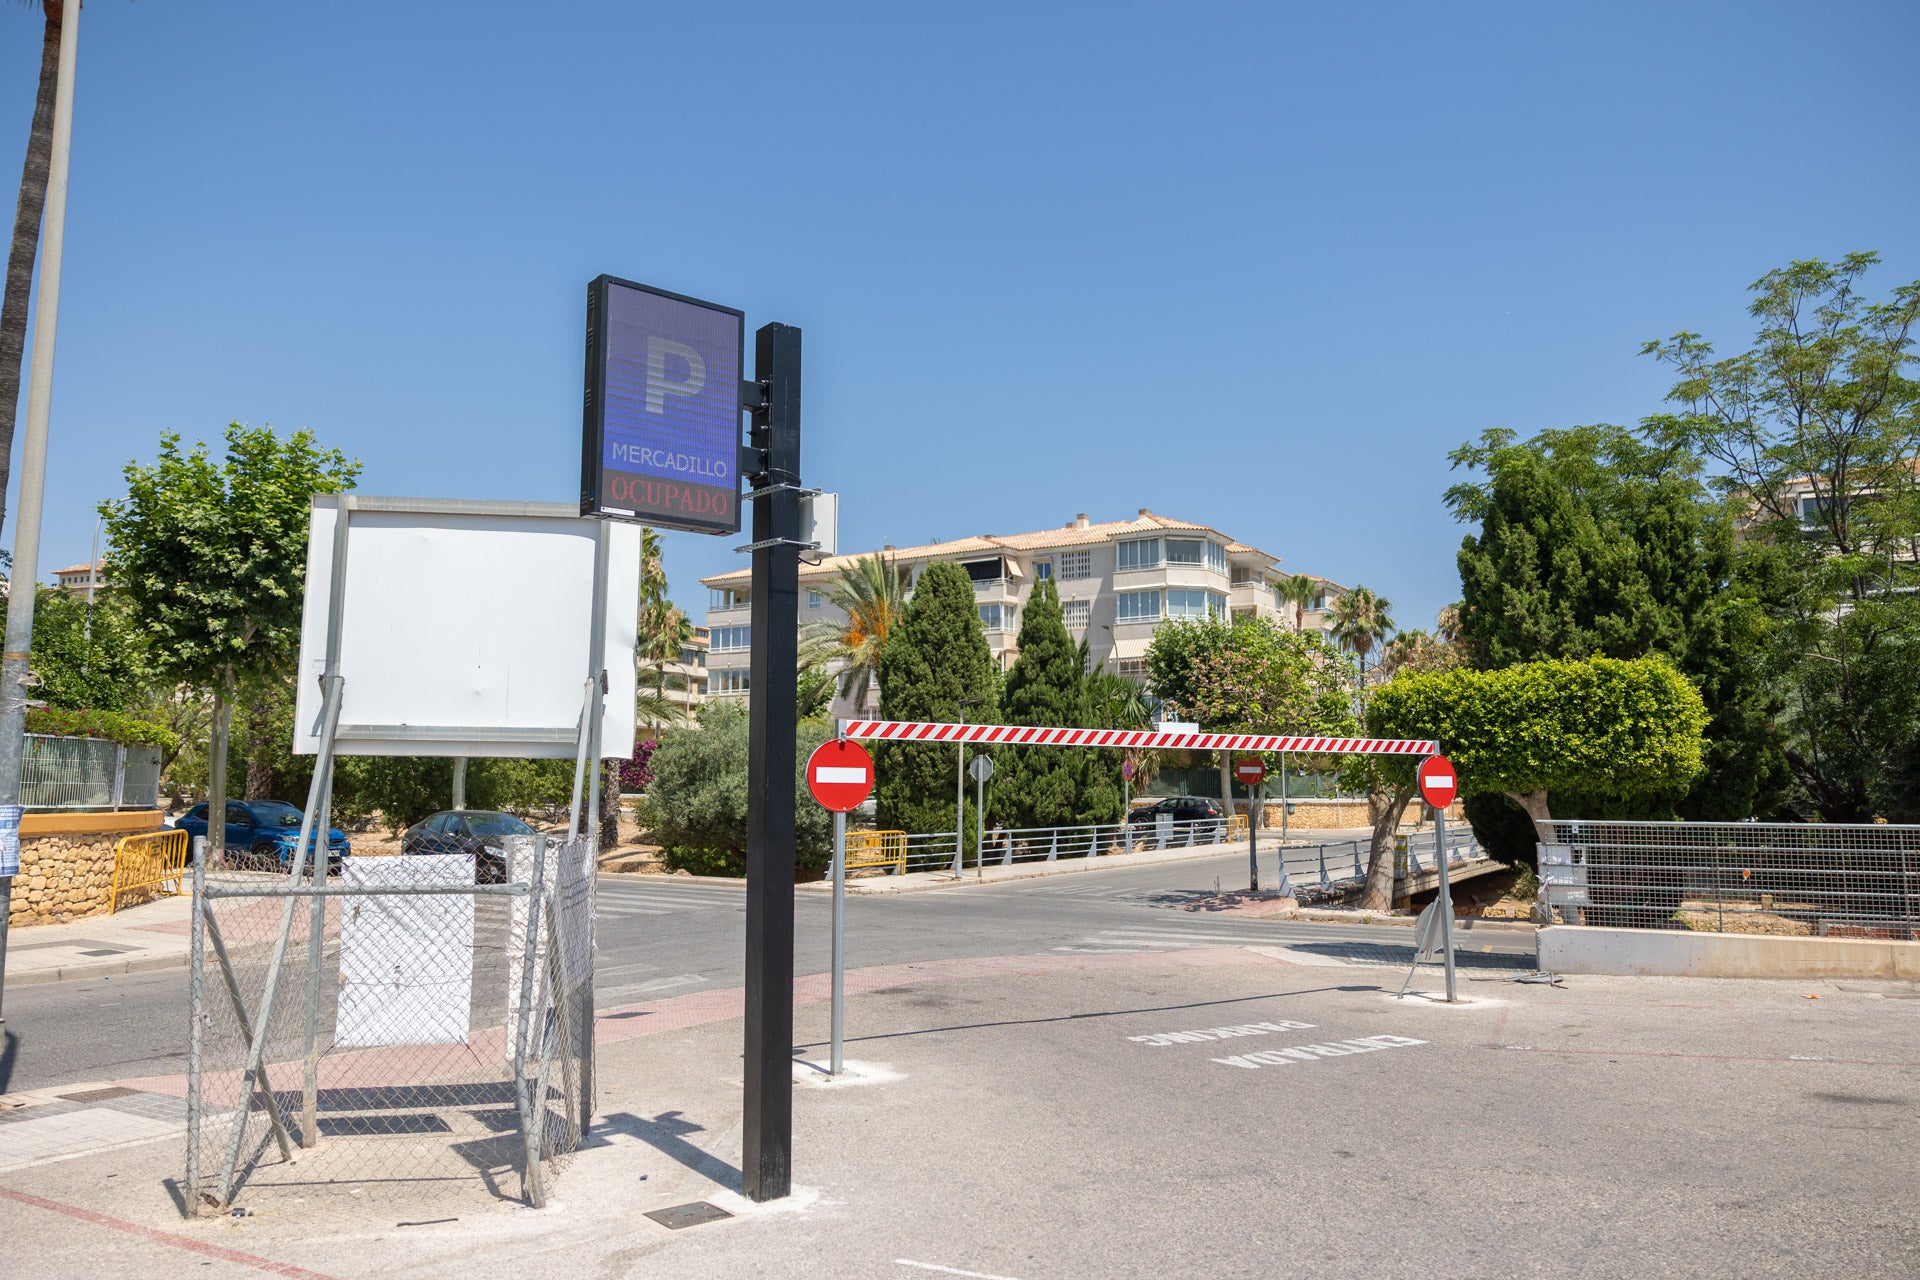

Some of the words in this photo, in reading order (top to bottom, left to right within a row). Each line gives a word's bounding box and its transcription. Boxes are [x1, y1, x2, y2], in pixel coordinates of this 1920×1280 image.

[646, 336, 706, 414] P
[612, 443, 727, 476] MERCADILLO
[611, 477, 728, 516] OCUPADO
[1126, 1020, 1317, 1046] PARKING
[1209, 1035, 1429, 1068] ENTRADA
